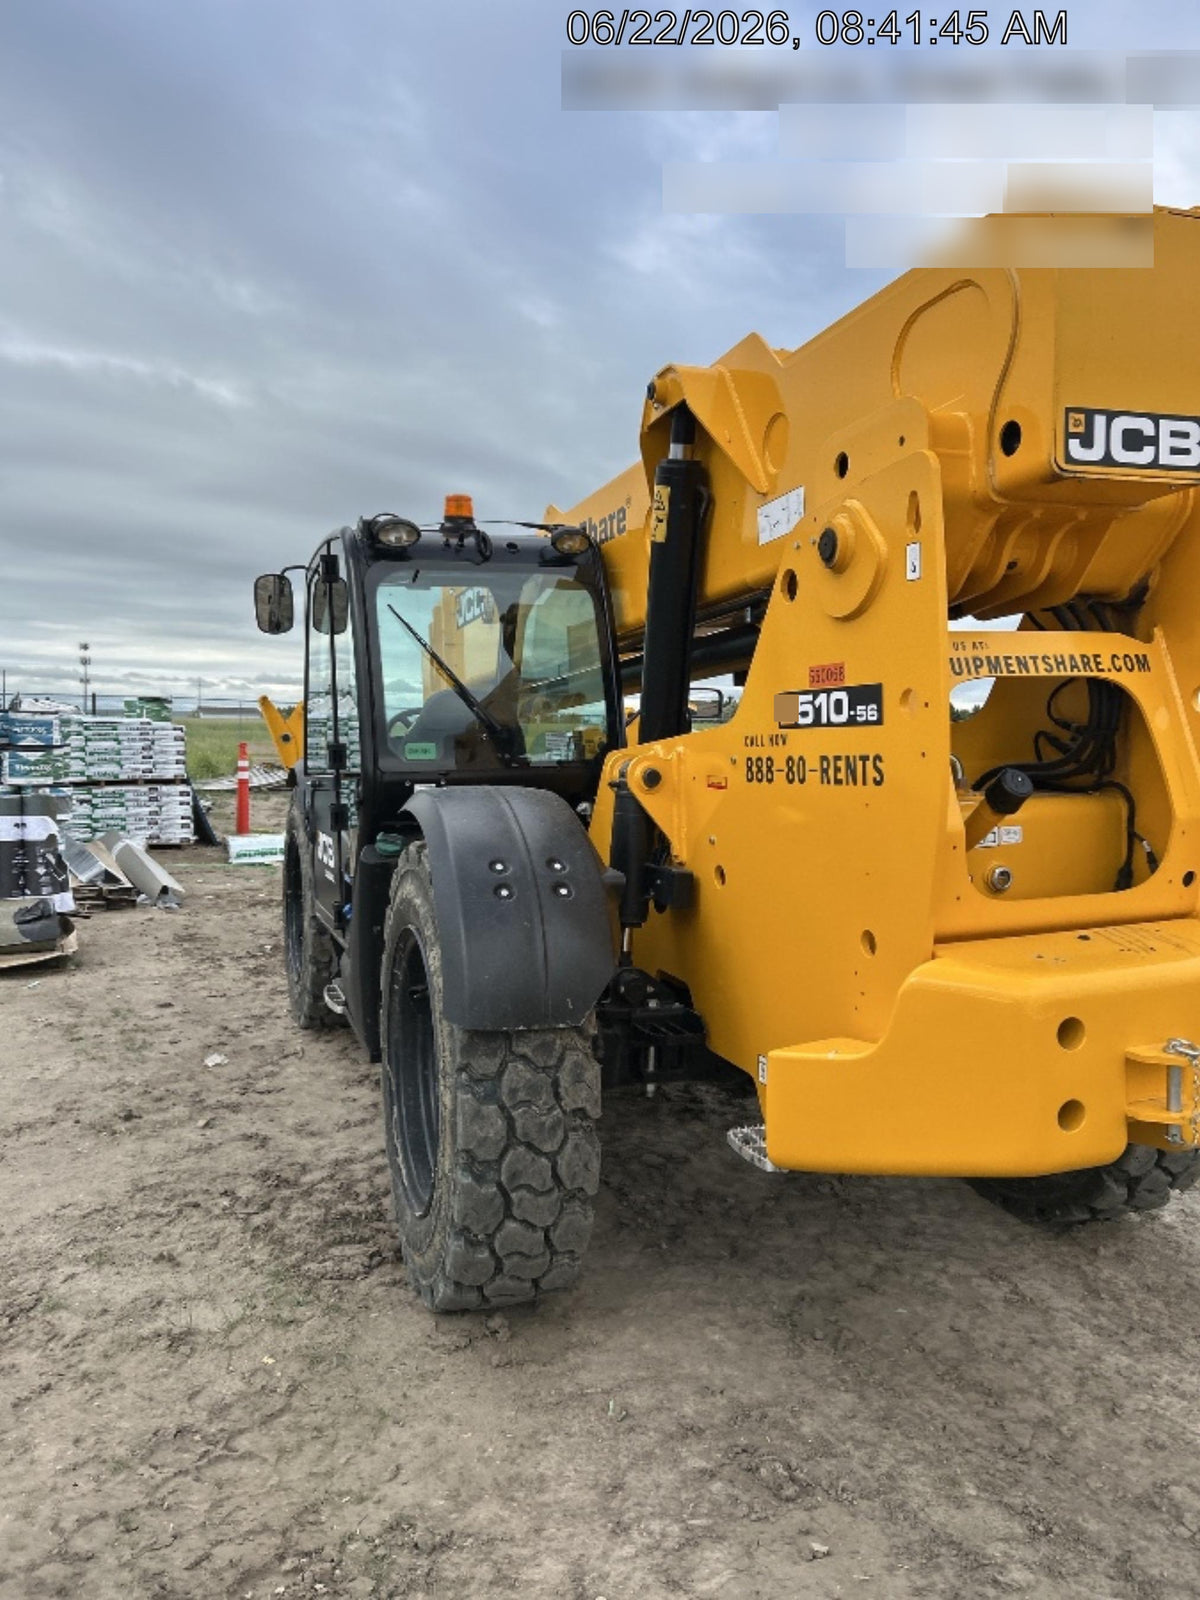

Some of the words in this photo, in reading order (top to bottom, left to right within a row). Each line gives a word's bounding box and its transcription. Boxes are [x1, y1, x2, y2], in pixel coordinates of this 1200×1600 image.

[1067, 413, 1200, 467] JCB
[949, 653, 1151, 676] UIPMENTSHARE.COM
[744, 734, 765, 748] CALL
[745, 753, 885, 787] 888-80-RENTS
